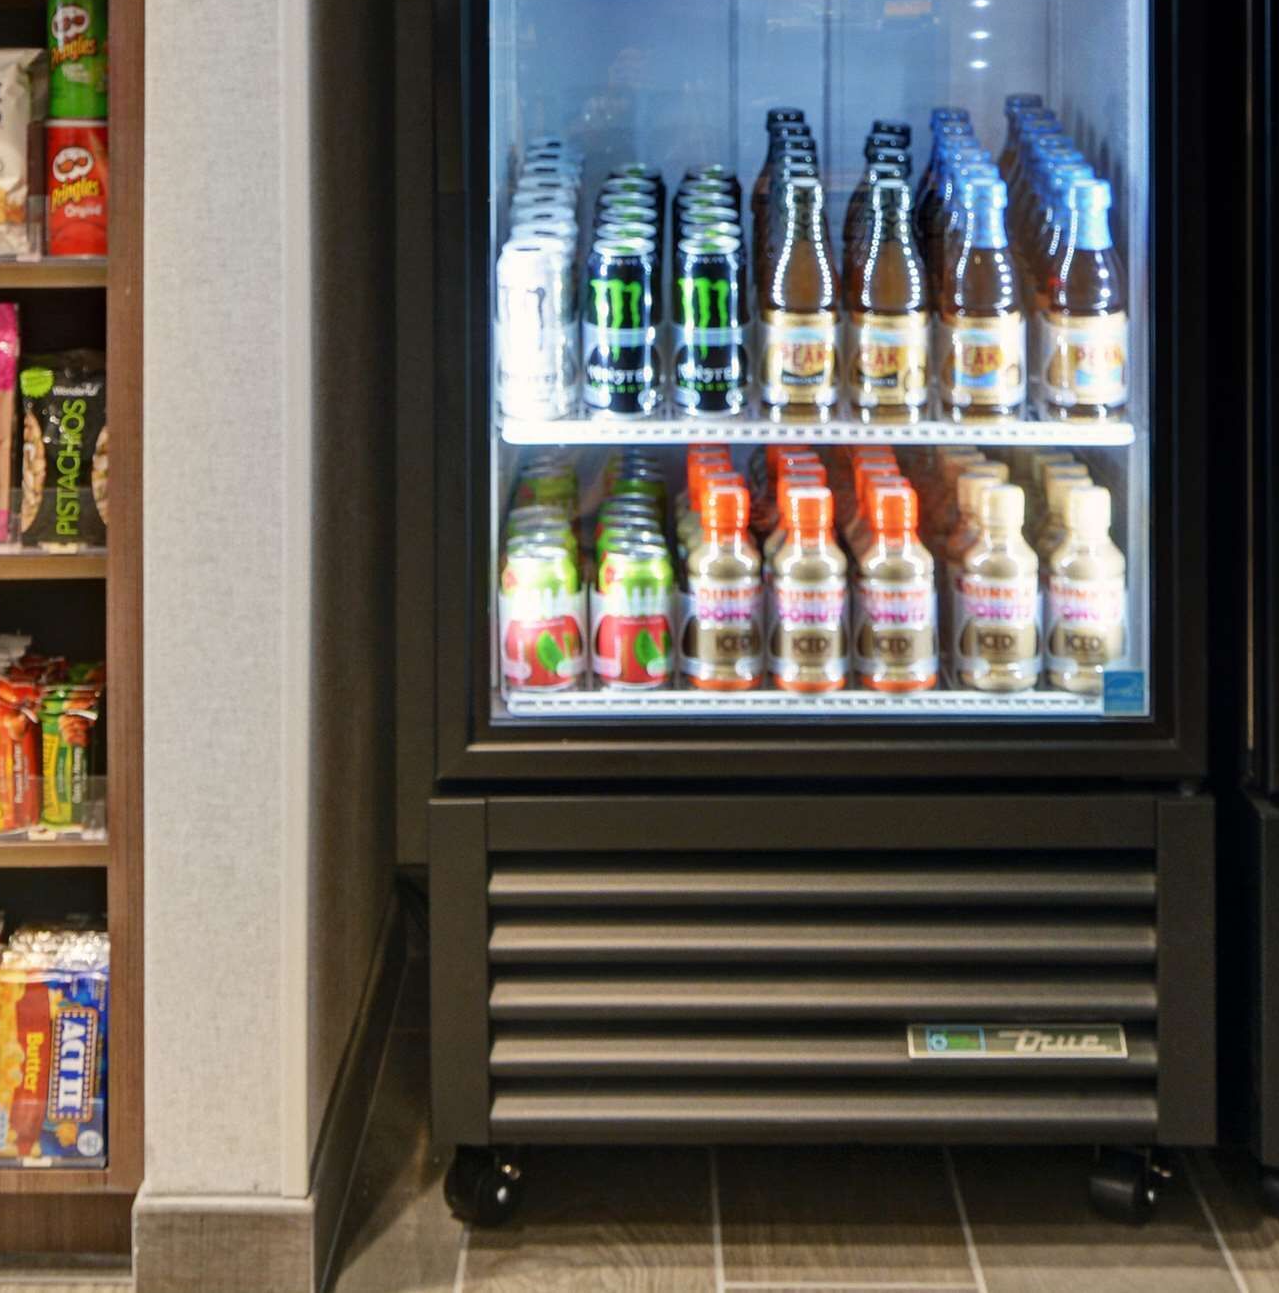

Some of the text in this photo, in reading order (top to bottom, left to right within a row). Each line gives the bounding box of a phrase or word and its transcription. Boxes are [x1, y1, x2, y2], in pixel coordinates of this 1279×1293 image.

[51, 178, 100, 212] Pringles
[56, 398, 88, 536] PISTACHIOS
[24, 1032, 44, 1094] Butter
